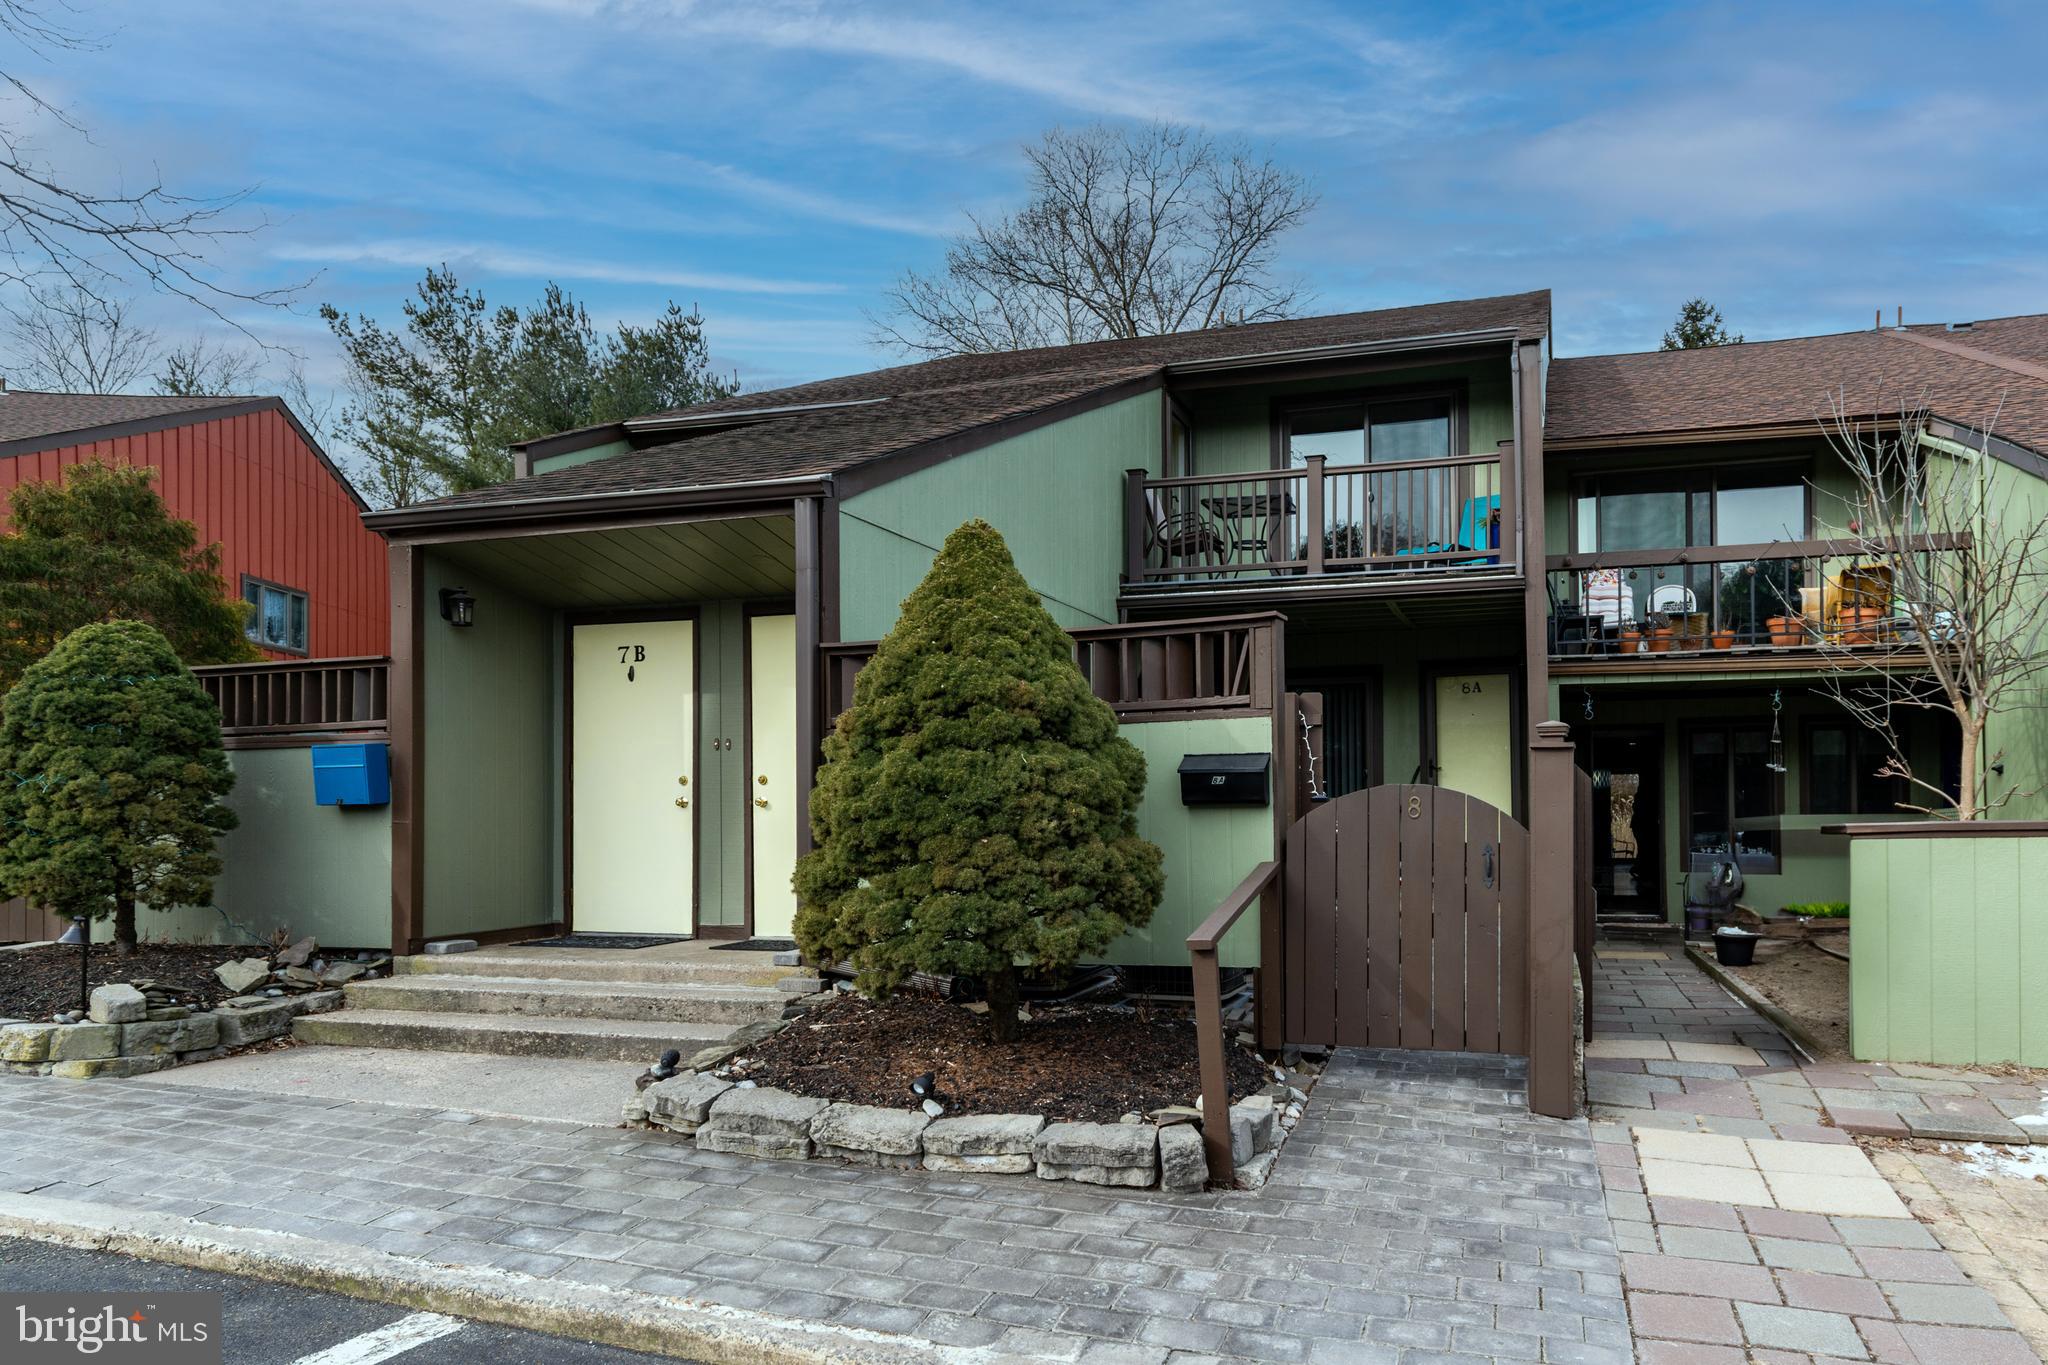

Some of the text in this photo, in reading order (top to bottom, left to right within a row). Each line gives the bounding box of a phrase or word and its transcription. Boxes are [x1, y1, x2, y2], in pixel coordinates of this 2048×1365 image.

[617, 645, 645, 663] 7B
[1462, 681, 1482, 694] 8A
[1408, 795, 1420, 819] 8
